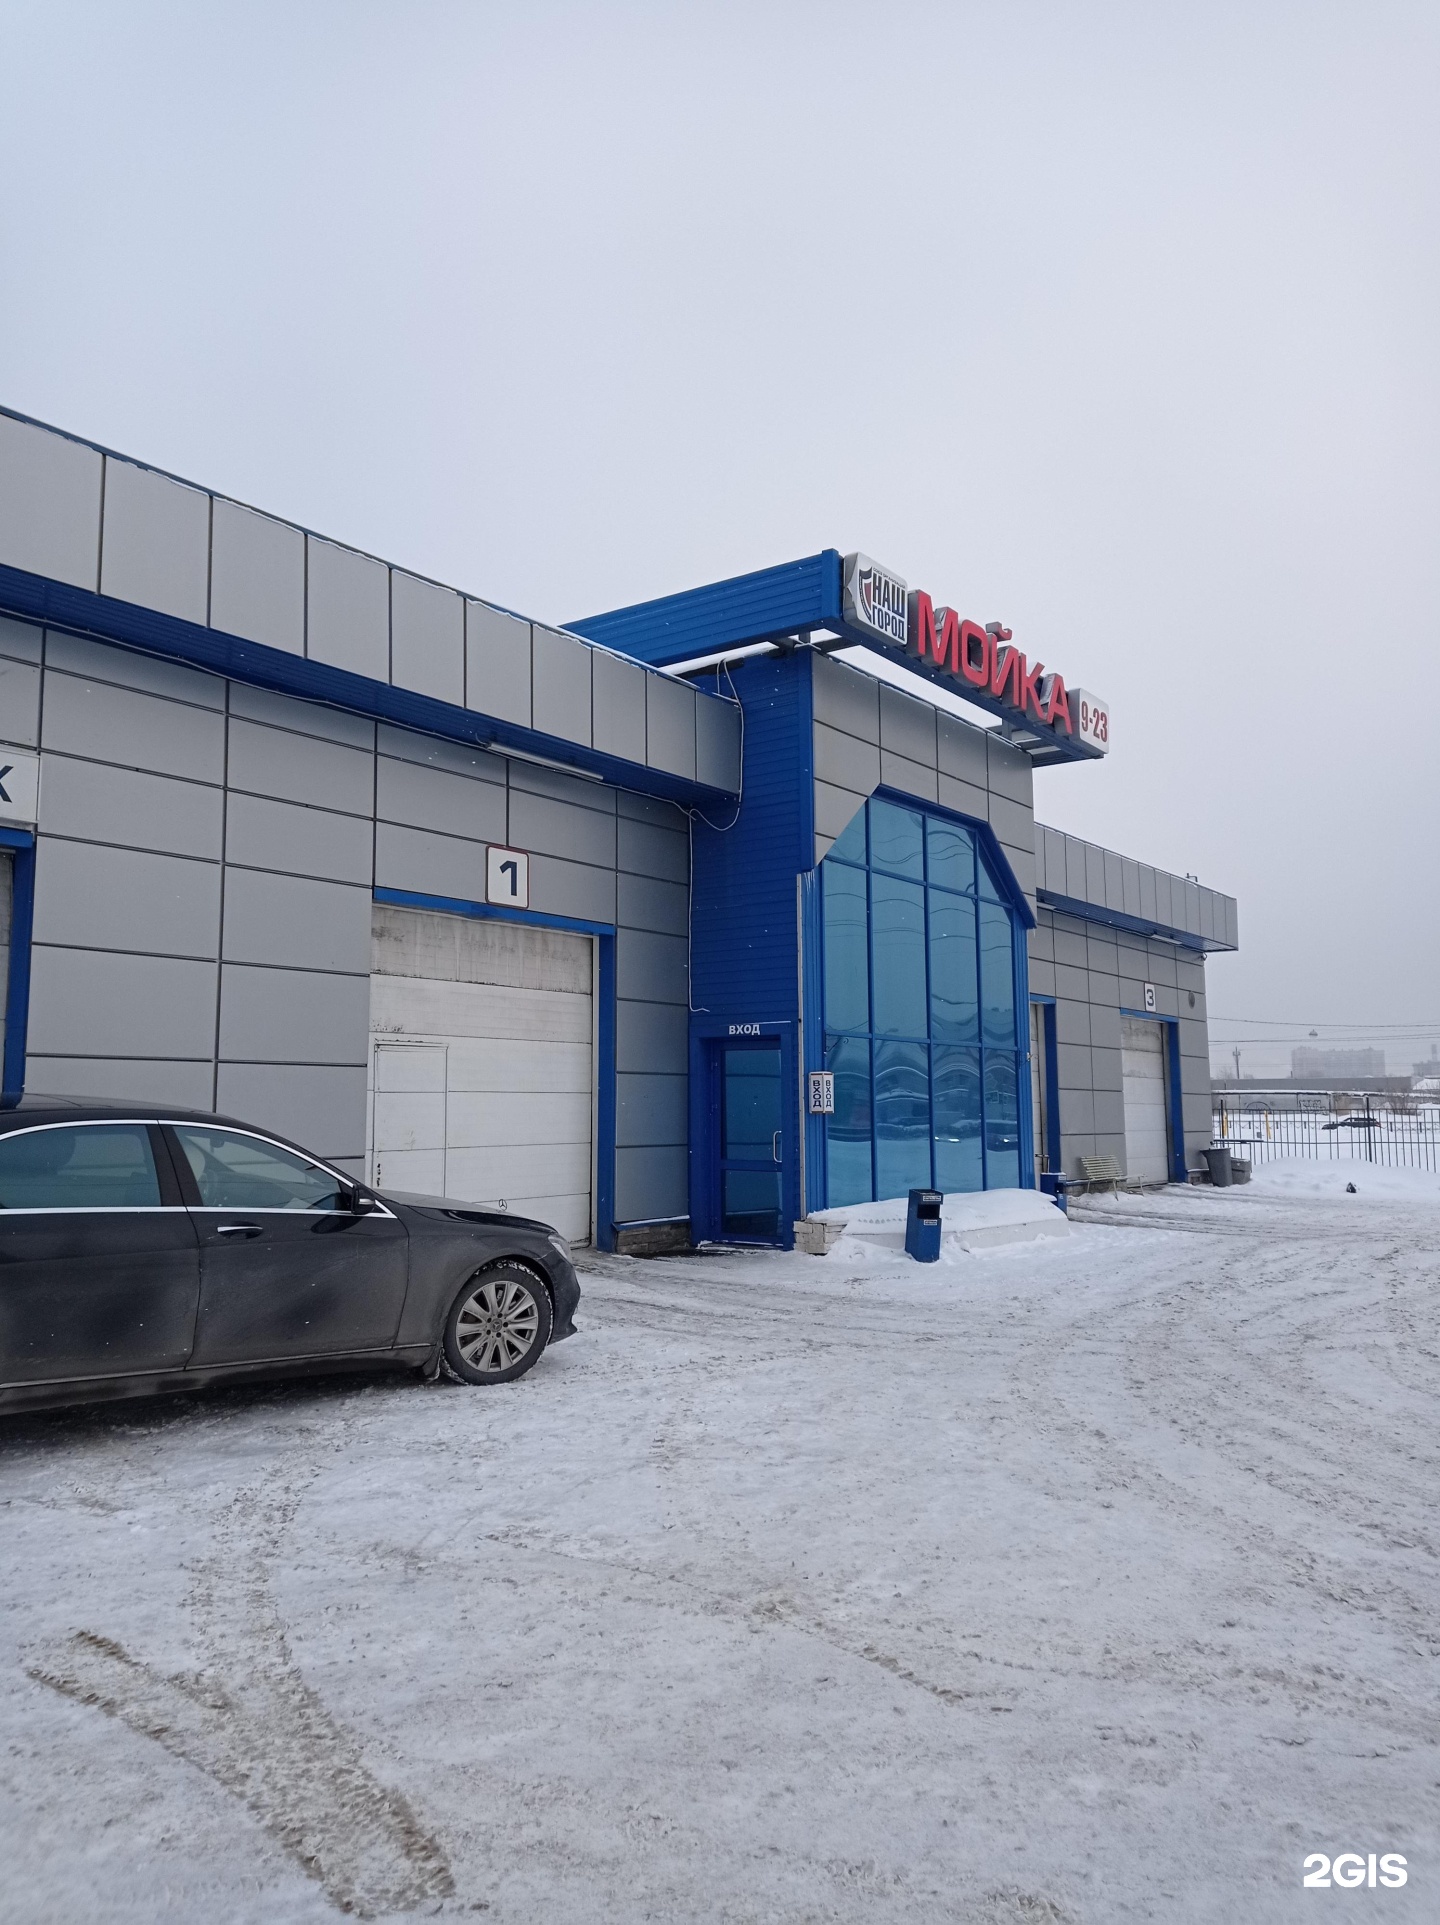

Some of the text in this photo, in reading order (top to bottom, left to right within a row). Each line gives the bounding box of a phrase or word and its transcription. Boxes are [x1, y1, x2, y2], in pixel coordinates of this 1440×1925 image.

[872, 572, 906, 619] НАШ
[872, 604, 906, 642] ГОРОД
[917, 590, 1073, 735] МОЙКА
[1081, 701, 1108, 743] 9-23
[499, 860, 518, 897] 1
[1146, 988, 1155, 1007] 3
[728, 1024, 761, 1036] ВХОД
[812, 1079, 822, 1108] ВХОД
